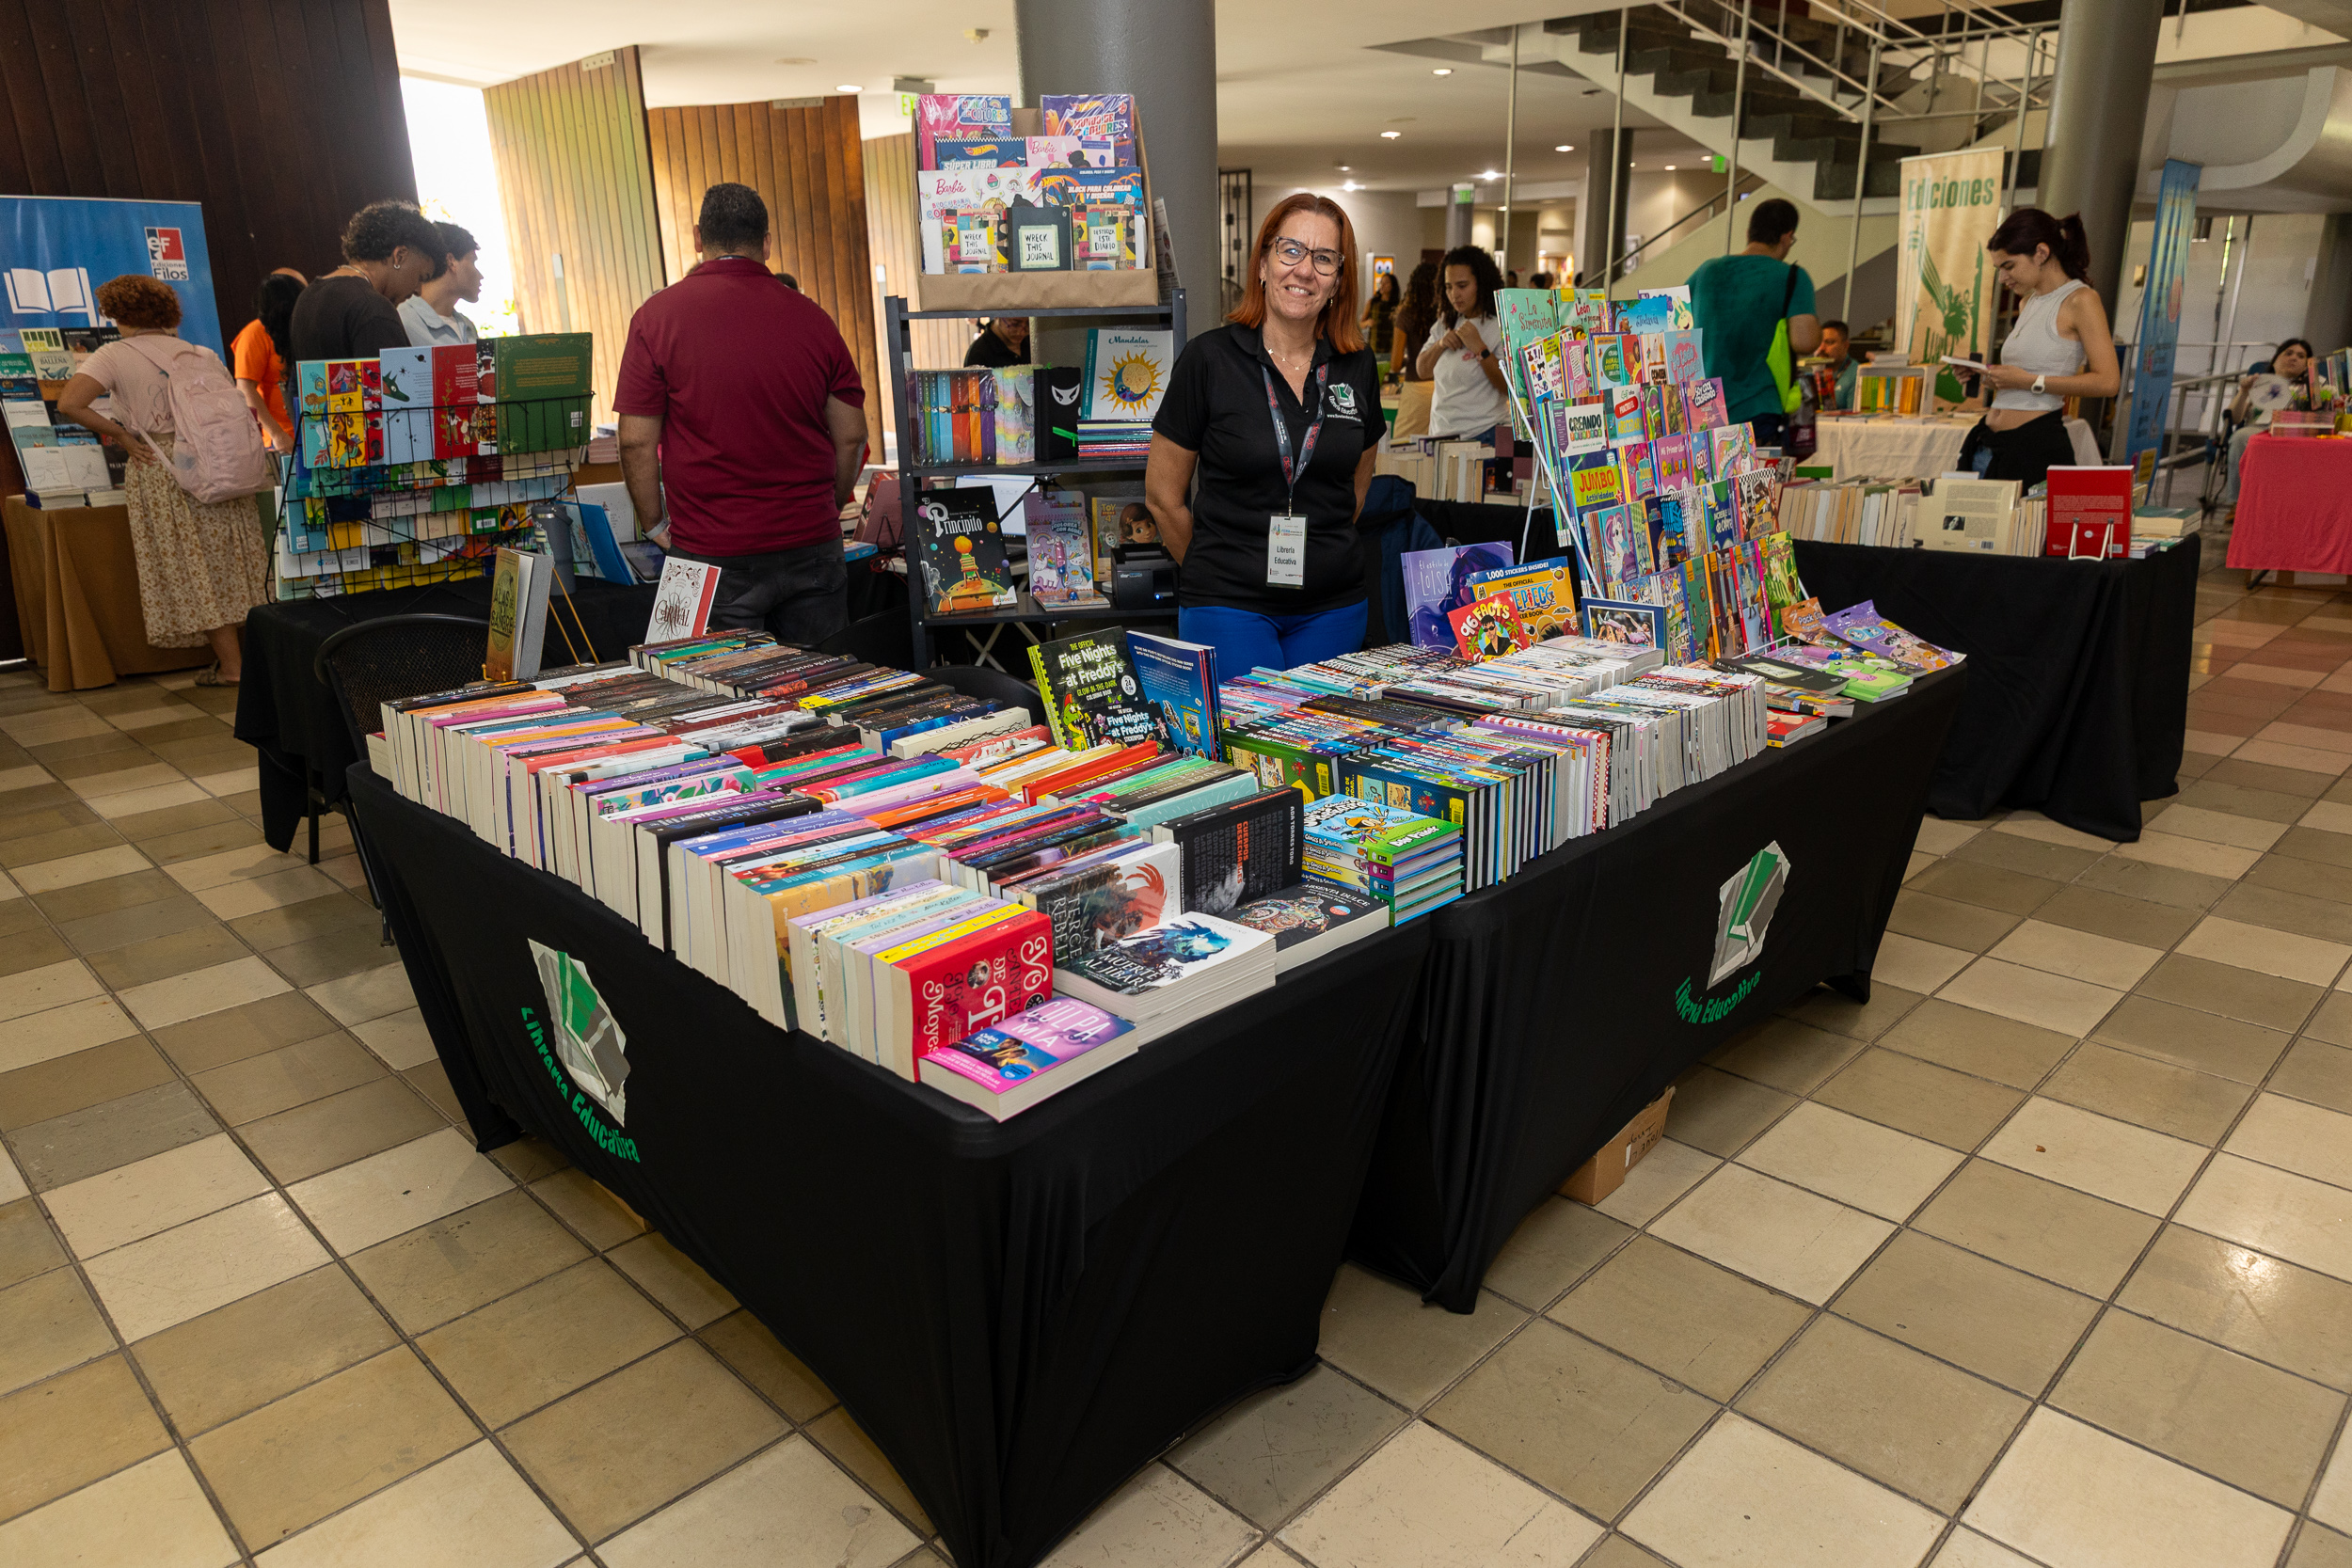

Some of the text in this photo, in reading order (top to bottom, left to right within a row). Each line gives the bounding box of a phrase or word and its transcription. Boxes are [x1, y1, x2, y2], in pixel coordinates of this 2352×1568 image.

[971, 108, 1009, 123] COLORES
[1073, 113, 1114, 128] MUNDO DE
[1083, 120, 1125, 136] COLORES
[1032, 141, 1057, 154] Barbie
[944, 160, 997, 169] SÚPER LIBRO
[936, 178, 966, 195] Barbie
[1907, 177, 1994, 212] Ediciones
[1025, 233, 1048, 243] WRECK
[1095, 242, 1116, 251] DIARIO
[1026, 243, 1042, 252] THIS
[1026, 252, 1054, 261] JOURNAL
[153, 267, 187, 280] Filos
[1526, 297, 1537, 316] La
[1575, 302, 1591, 316] León
[1519, 311, 1552, 331] Sirenita
[1108, 336, 1150, 344] Mandalas
[1568, 414, 1602, 432] CREANDO
[1661, 443, 1678, 455] Mi Primer
[1579, 469, 1615, 493] JUMBO
[922, 497, 930, 505] El
[1586, 491, 1614, 503] Actividades
[926, 502, 983, 538] Principito
[1277, 546, 1295, 554] Librería
[1274, 557, 1296, 565] Educativa
[1486, 562, 1549, 580] 1,000 STICKERS INSIDE!
[1420, 567, 1454, 596] LOISH
[1512, 578, 1534, 587] OFFICIAL
[1472, 601, 1510, 621] FACTS
[1529, 610, 1544, 619] BOOK
[491, 610, 513, 635] SANGRE
[1460, 614, 1479, 637] 96
[1070, 640, 1096, 651] THE OFFICIAL
[1058, 652, 1081, 670] Five
[1081, 643, 1118, 662] Nights
[756, 664, 812, 681] CINCO ARMAS
[1066, 674, 1078, 688] at
[1078, 660, 1124, 685] Freddy's
[1076, 679, 1118, 697] GLOW-IN-THE-DARK
[1124, 678, 1132, 687] 24
[1086, 689, 1112, 702] COLORING BOOK
[1106, 710, 1150, 726] Five Nights
[1111, 722, 1153, 736] at Freddy's
[965, 739, 995, 752] Regretting
[1075, 778, 1094, 788] Deja
[681, 808, 727, 821] ASISTENTE
[751, 796, 784, 807] VILLAN
[708, 805, 767, 824] ETÉREO
[729, 826, 761, 836] HANNAH
[1387, 825, 1440, 847] DAV PILKEY
[725, 838, 788, 855] HANNAH GRACE
[829, 852, 855, 861] MARIDOS
[782, 869, 818, 884] DONDE
[819, 863, 845, 874] TODO
[848, 854, 879, 867] BRILLA
[924, 895, 961, 911] Alice Kellen
[928, 909, 953, 921] ROMPER
[961, 896, 987, 909] CÍRCULO
[1343, 894, 1371, 907] DULCE
[869, 918, 926, 940] COLLEEN HOOVER
[1054, 896, 1066, 963] REBELI
[1069, 893, 1082, 959] TERCE
[1082, 928, 1089, 943] LA
[993, 956, 1007, 984] DE
[1080, 958, 1151, 989] AL JÍBAR
[1099, 952, 1162, 980] MUERTE
[1006, 947, 1022, 1017] ANTES
[943, 972, 964, 1016] Jojo
[1675, 971, 1761, 1024] Librería Educativa
[922, 980, 945, 1054] Moyes
[1070, 1000, 1111, 1020] MERCEDES RON
[1026, 1000, 1111, 1042] CULPA
[1011, 1022, 1059, 1048] MÍA
[520, 1006, 641, 1163] Librería Educativa
